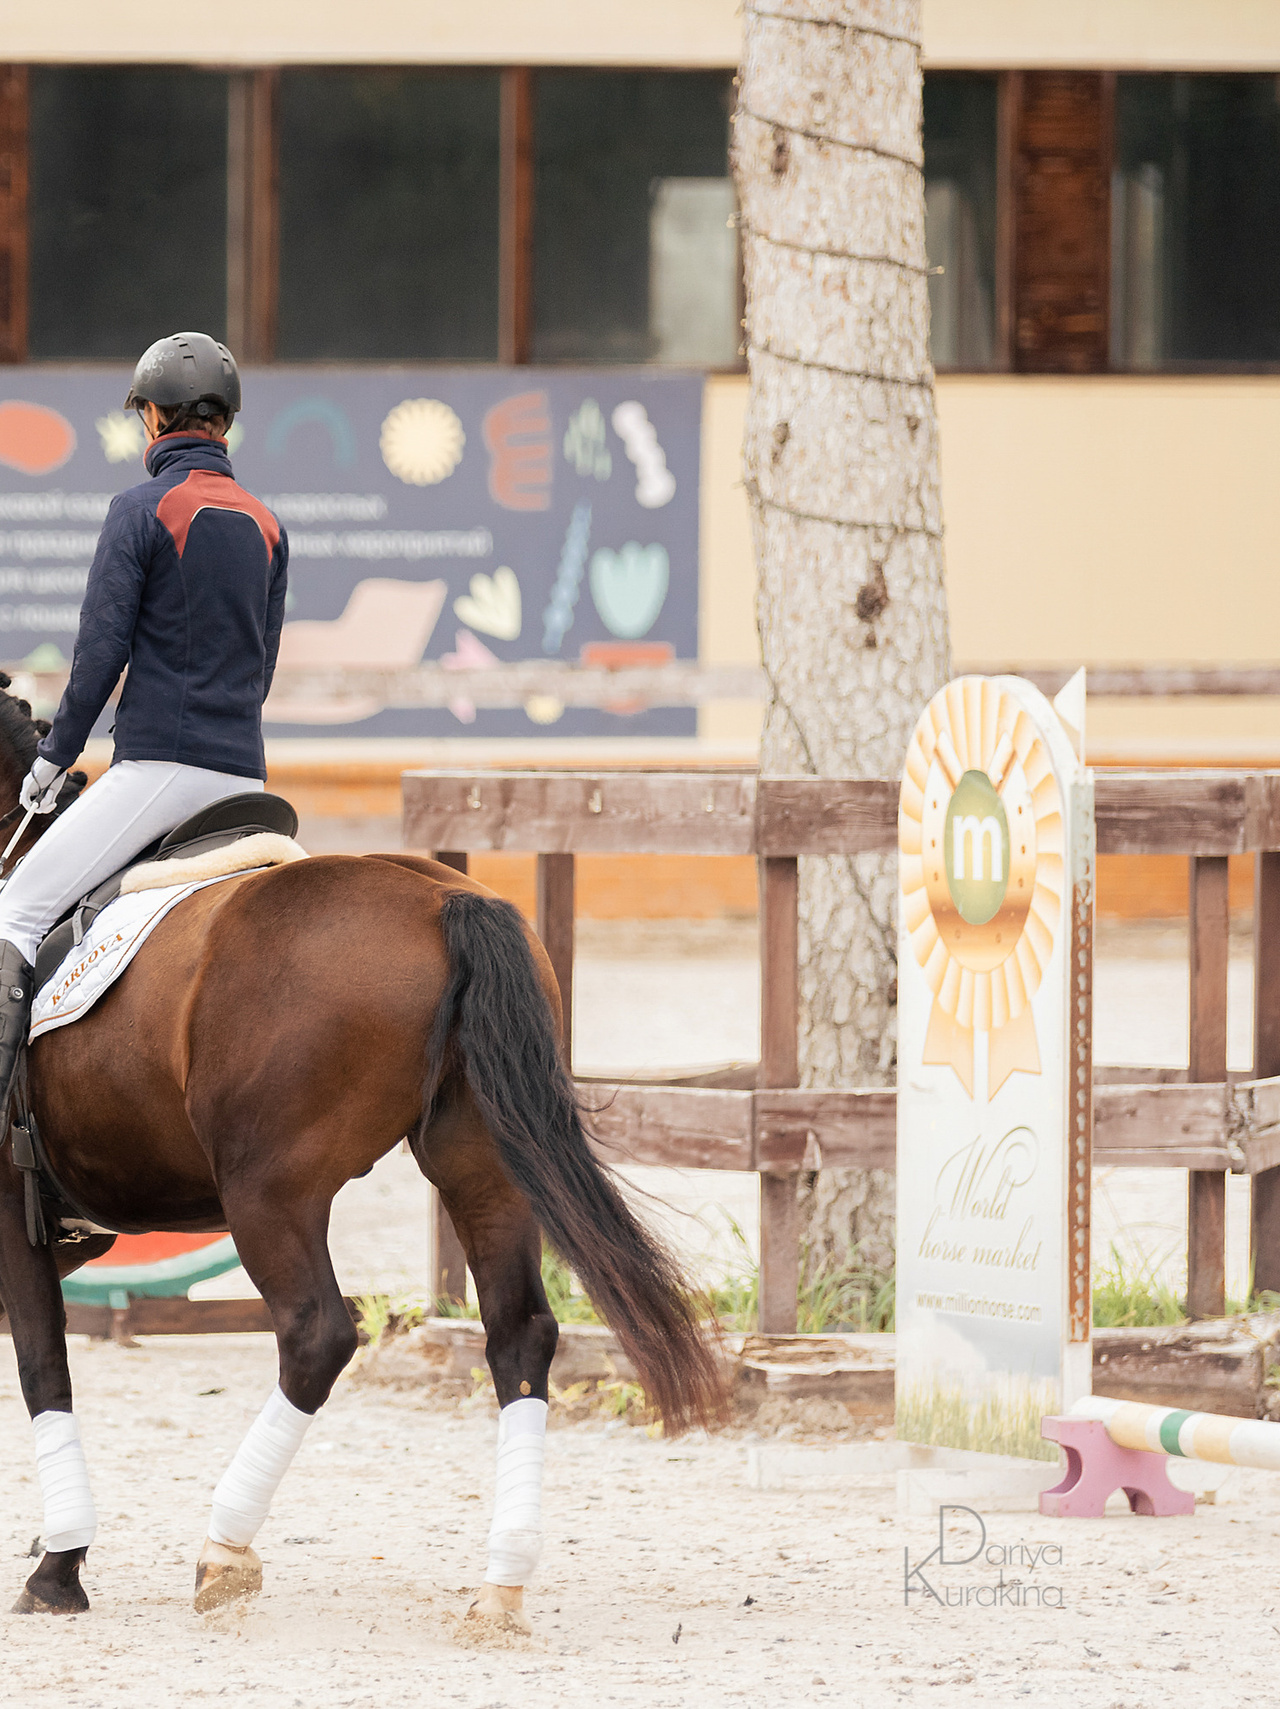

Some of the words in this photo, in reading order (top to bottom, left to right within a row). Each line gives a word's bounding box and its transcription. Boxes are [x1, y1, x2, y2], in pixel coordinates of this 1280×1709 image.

[51, 933, 123, 1006] KARLOVA
[934, 1125, 1039, 1220] World
[918, 1204, 967, 1263] horse
[972, 1215, 1042, 1271] market
[916, 1290, 1042, 1322] www.millionhorse.com
